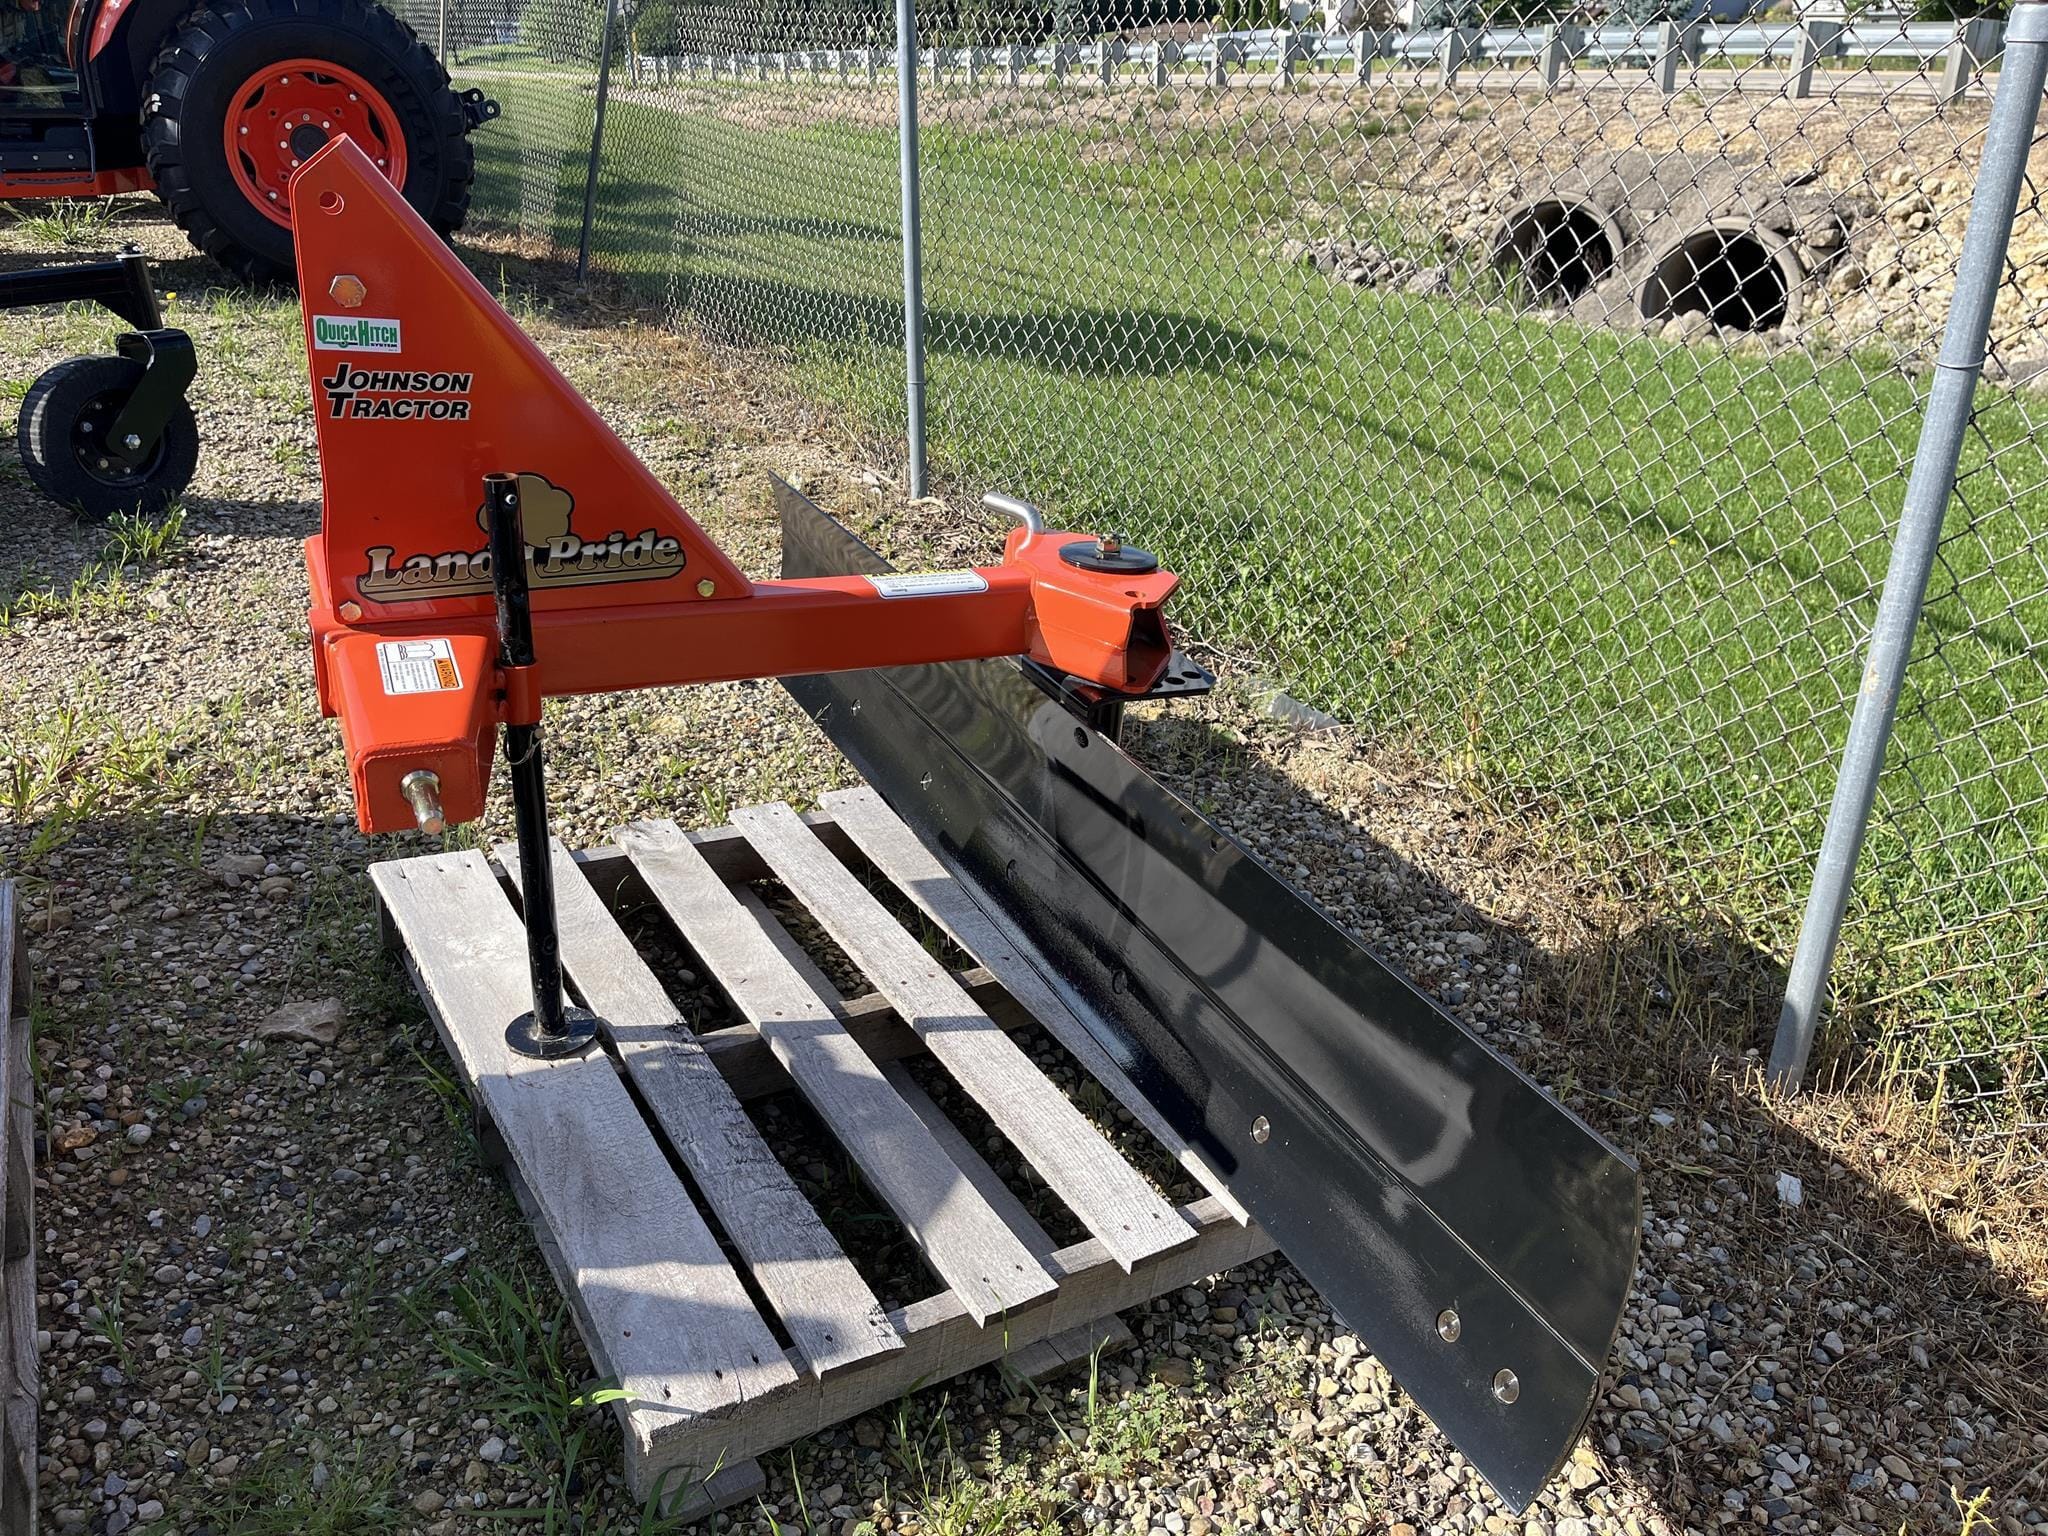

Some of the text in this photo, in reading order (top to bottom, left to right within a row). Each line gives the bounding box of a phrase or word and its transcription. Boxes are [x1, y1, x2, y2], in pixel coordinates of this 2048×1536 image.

[322, 362, 473, 393] JOHNSON
[328, 392, 471, 420] TRACTOR
[544, 528, 682, 573] Pride
